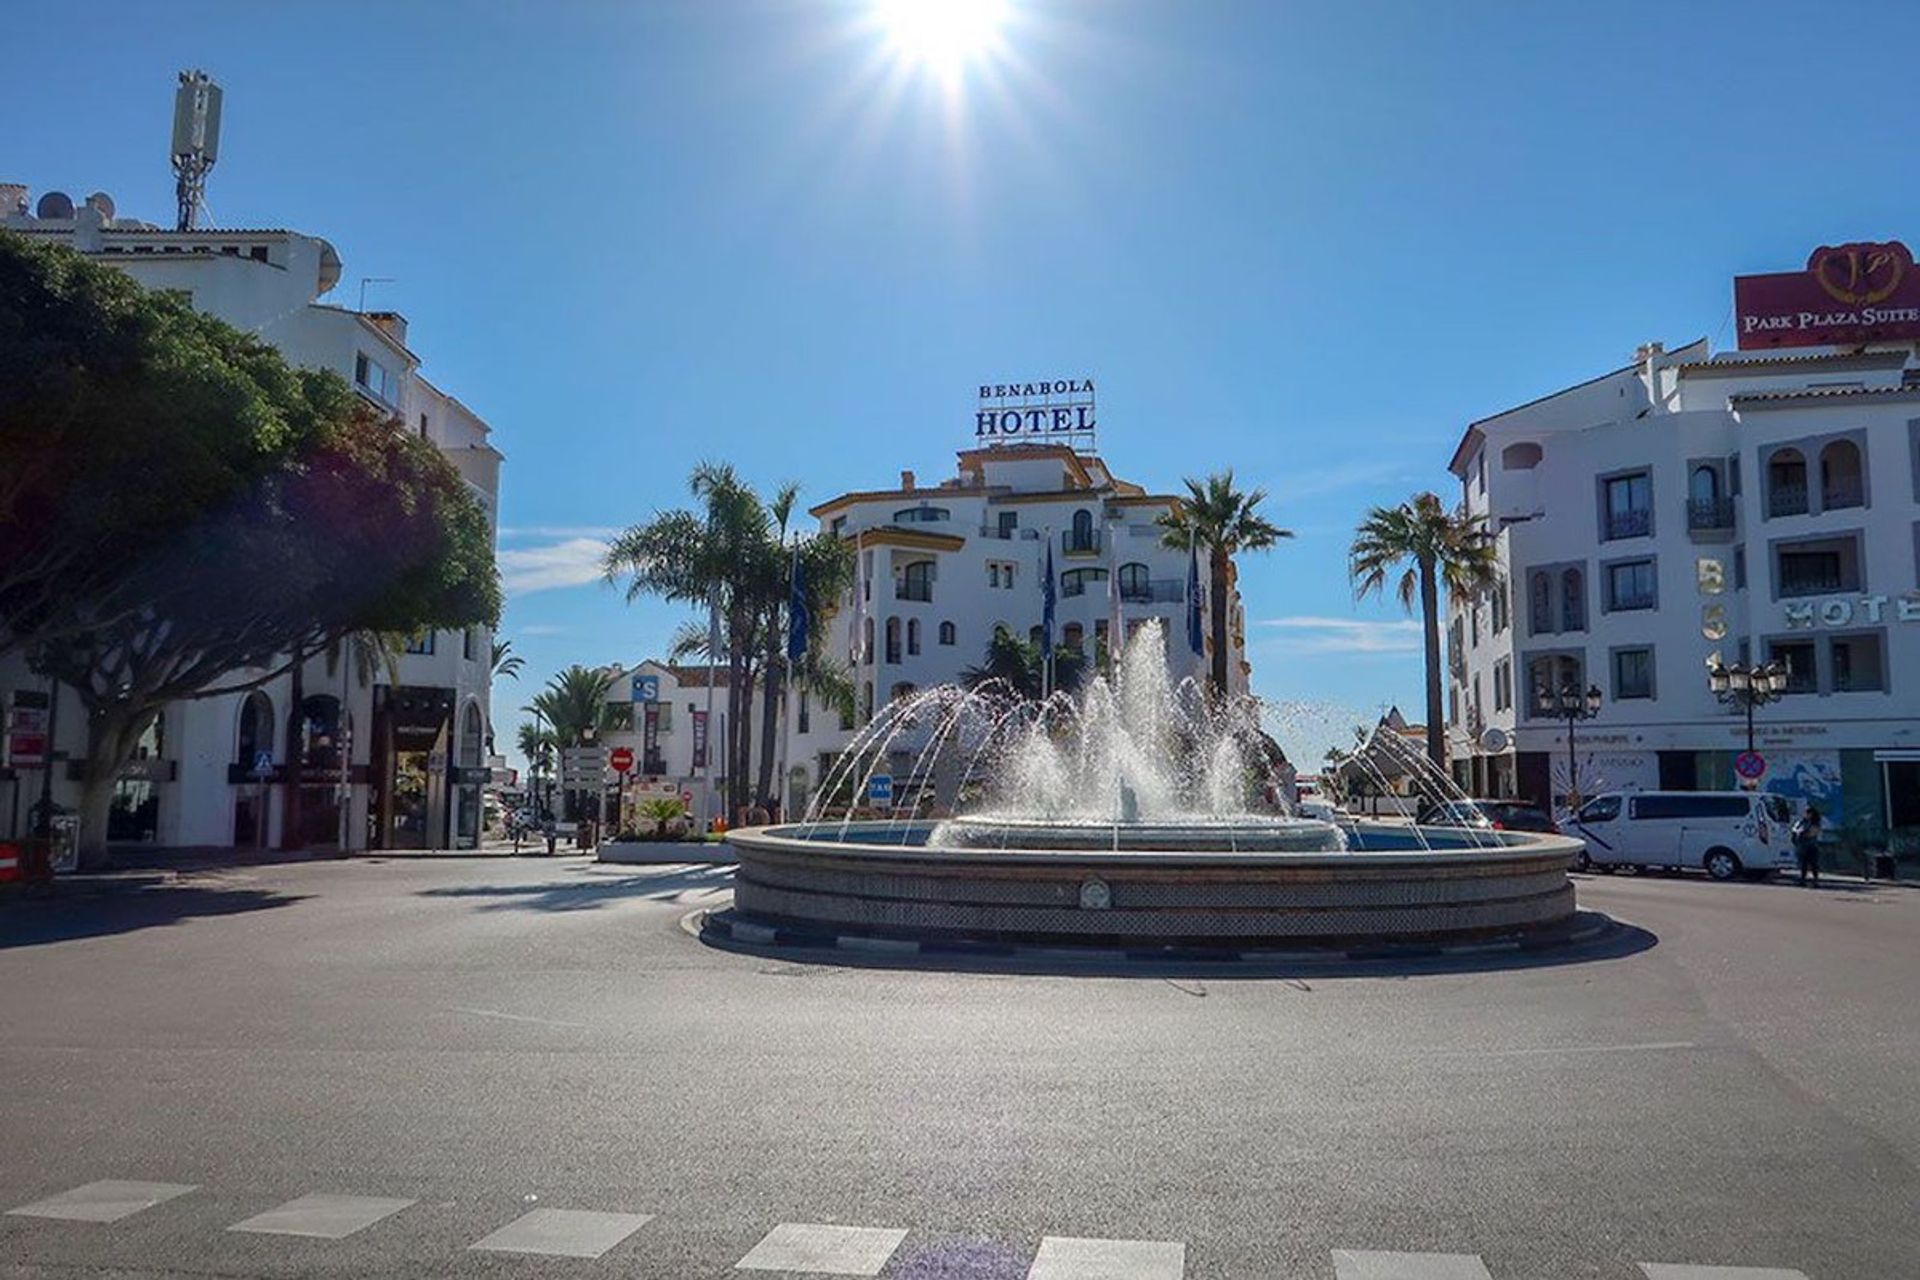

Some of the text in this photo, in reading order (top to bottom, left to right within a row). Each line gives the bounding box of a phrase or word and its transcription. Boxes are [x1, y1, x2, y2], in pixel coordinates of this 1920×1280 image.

[1743, 308, 1920, 333] PARK PLAZA SUITE
[980, 380, 1094, 398] BENABOLA
[975, 407, 1096, 436] HOTEL
